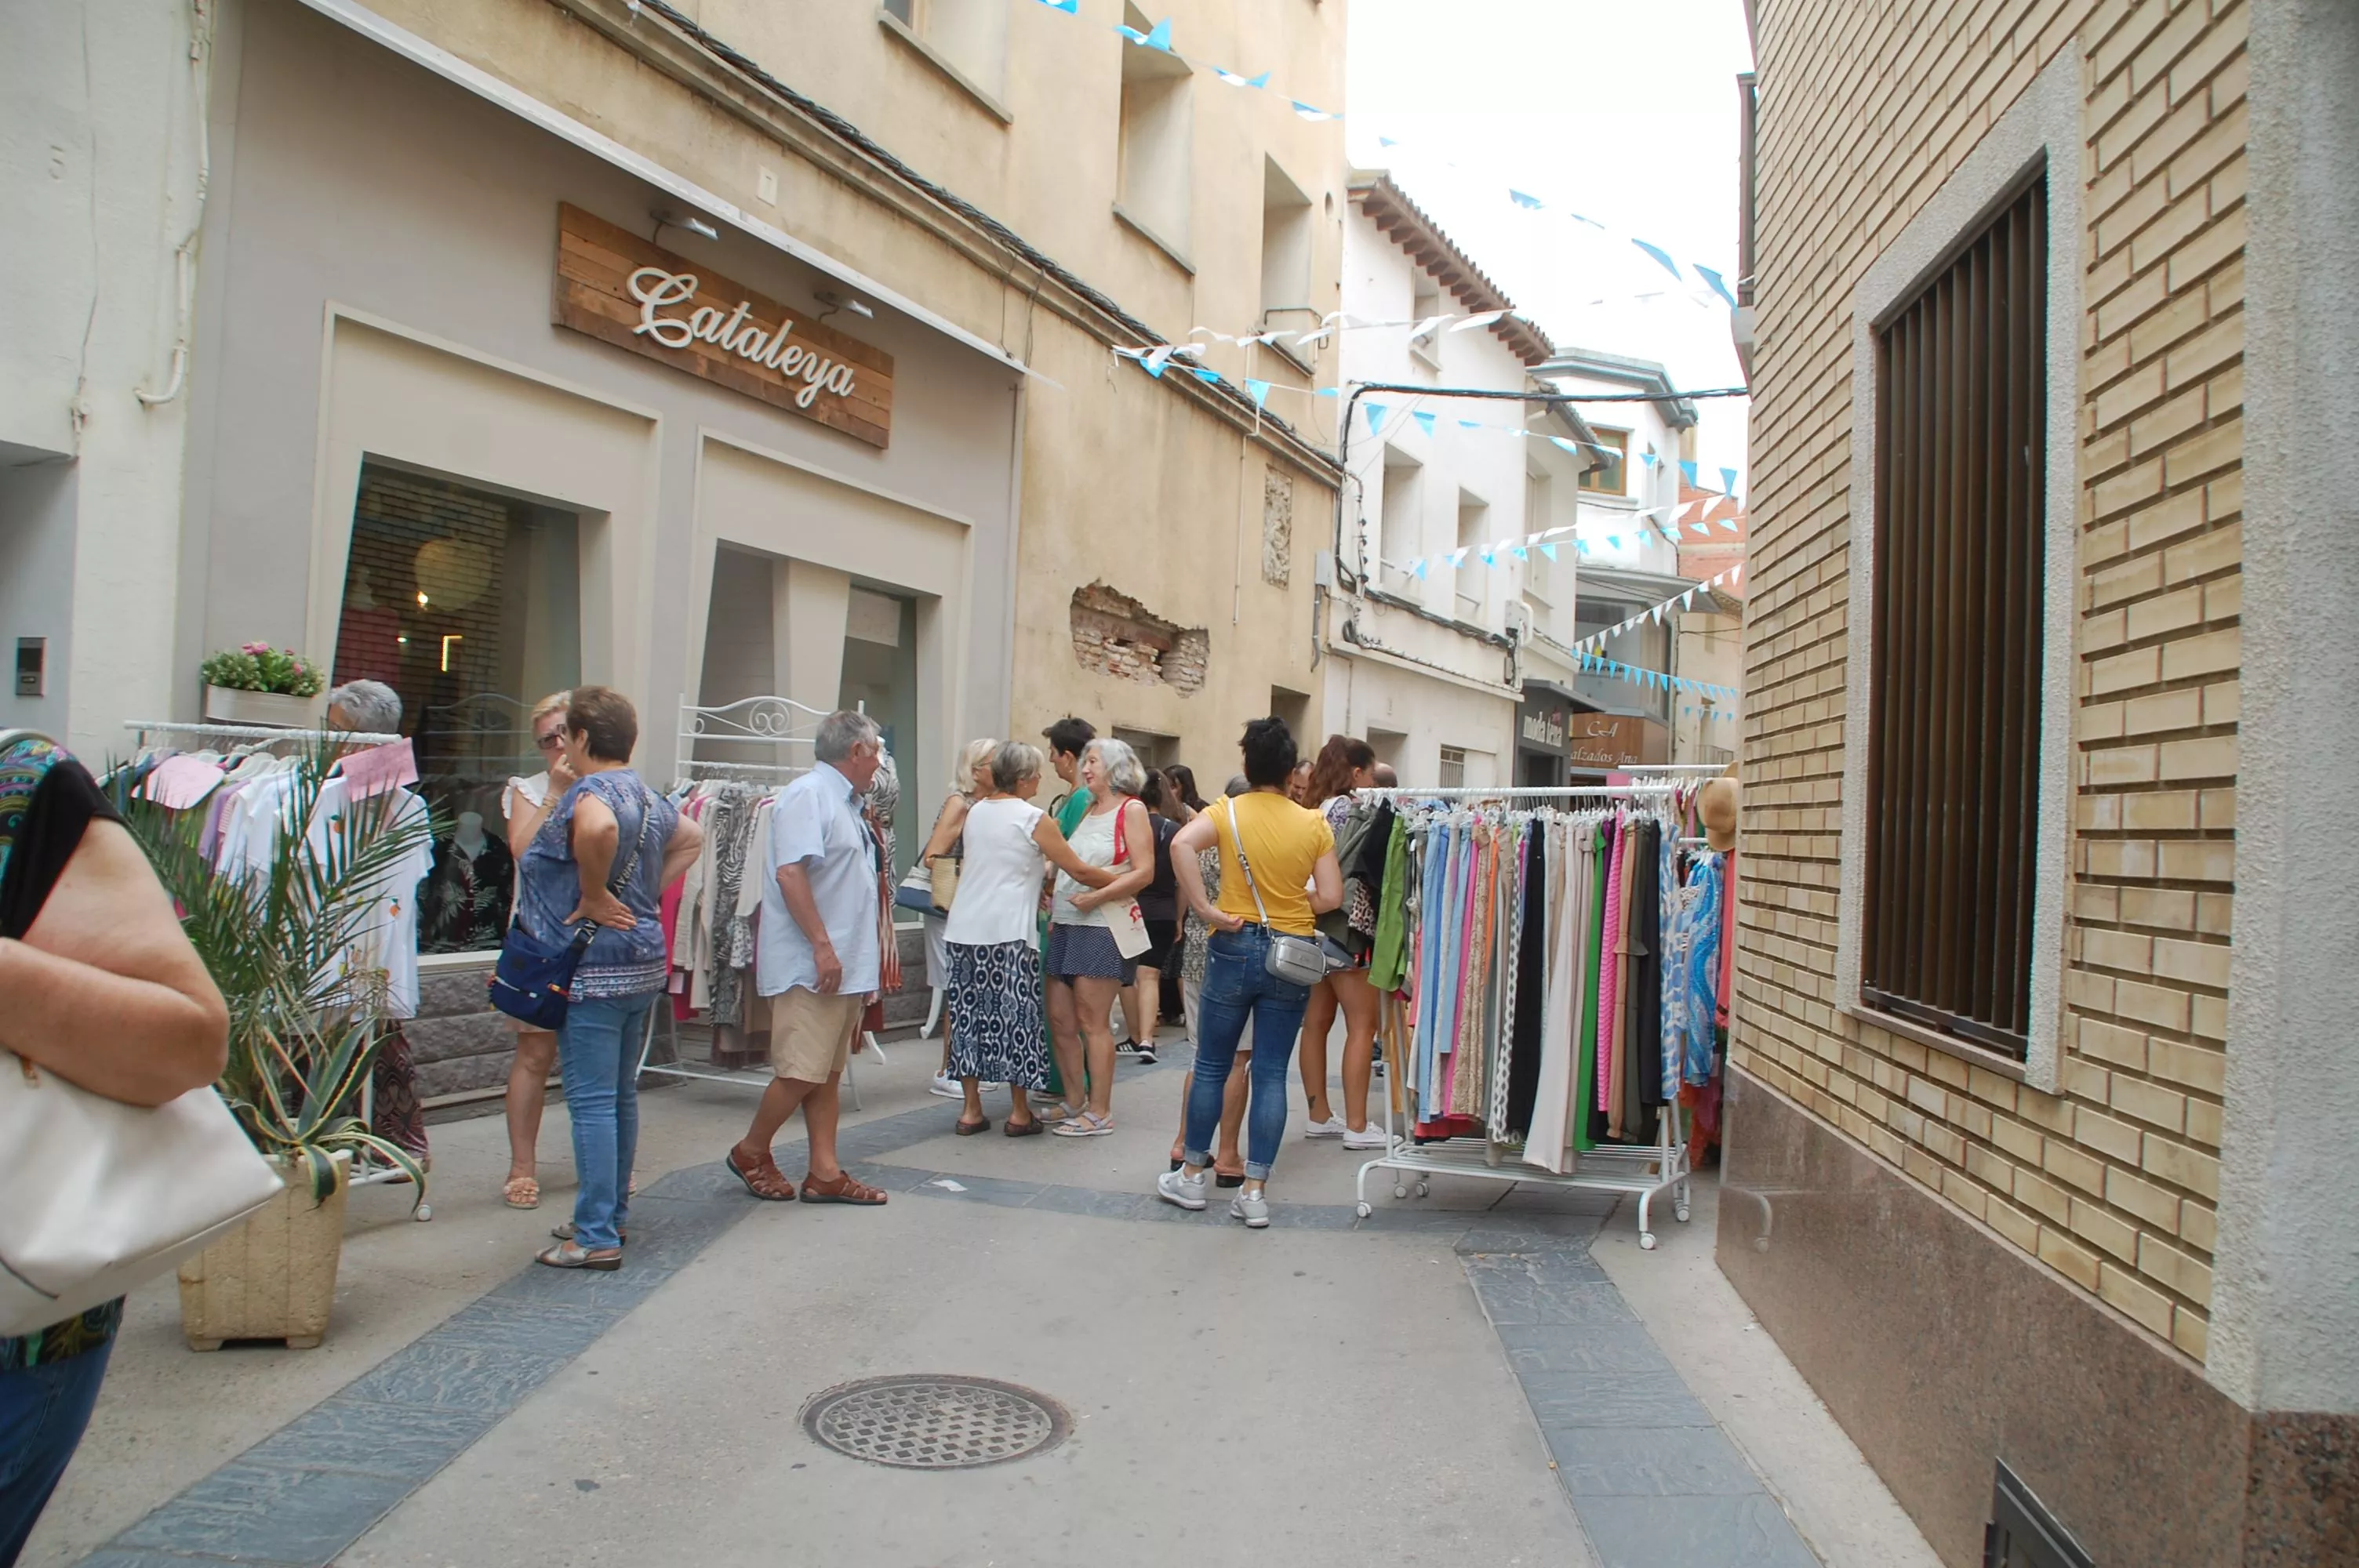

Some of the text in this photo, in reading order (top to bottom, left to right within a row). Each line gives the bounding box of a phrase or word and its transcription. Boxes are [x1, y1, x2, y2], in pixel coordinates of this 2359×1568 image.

[626, 267, 856, 408] Cataleya
[1587, 720, 1619, 738] CA
[1571, 746, 1638, 765] alzados Ana
